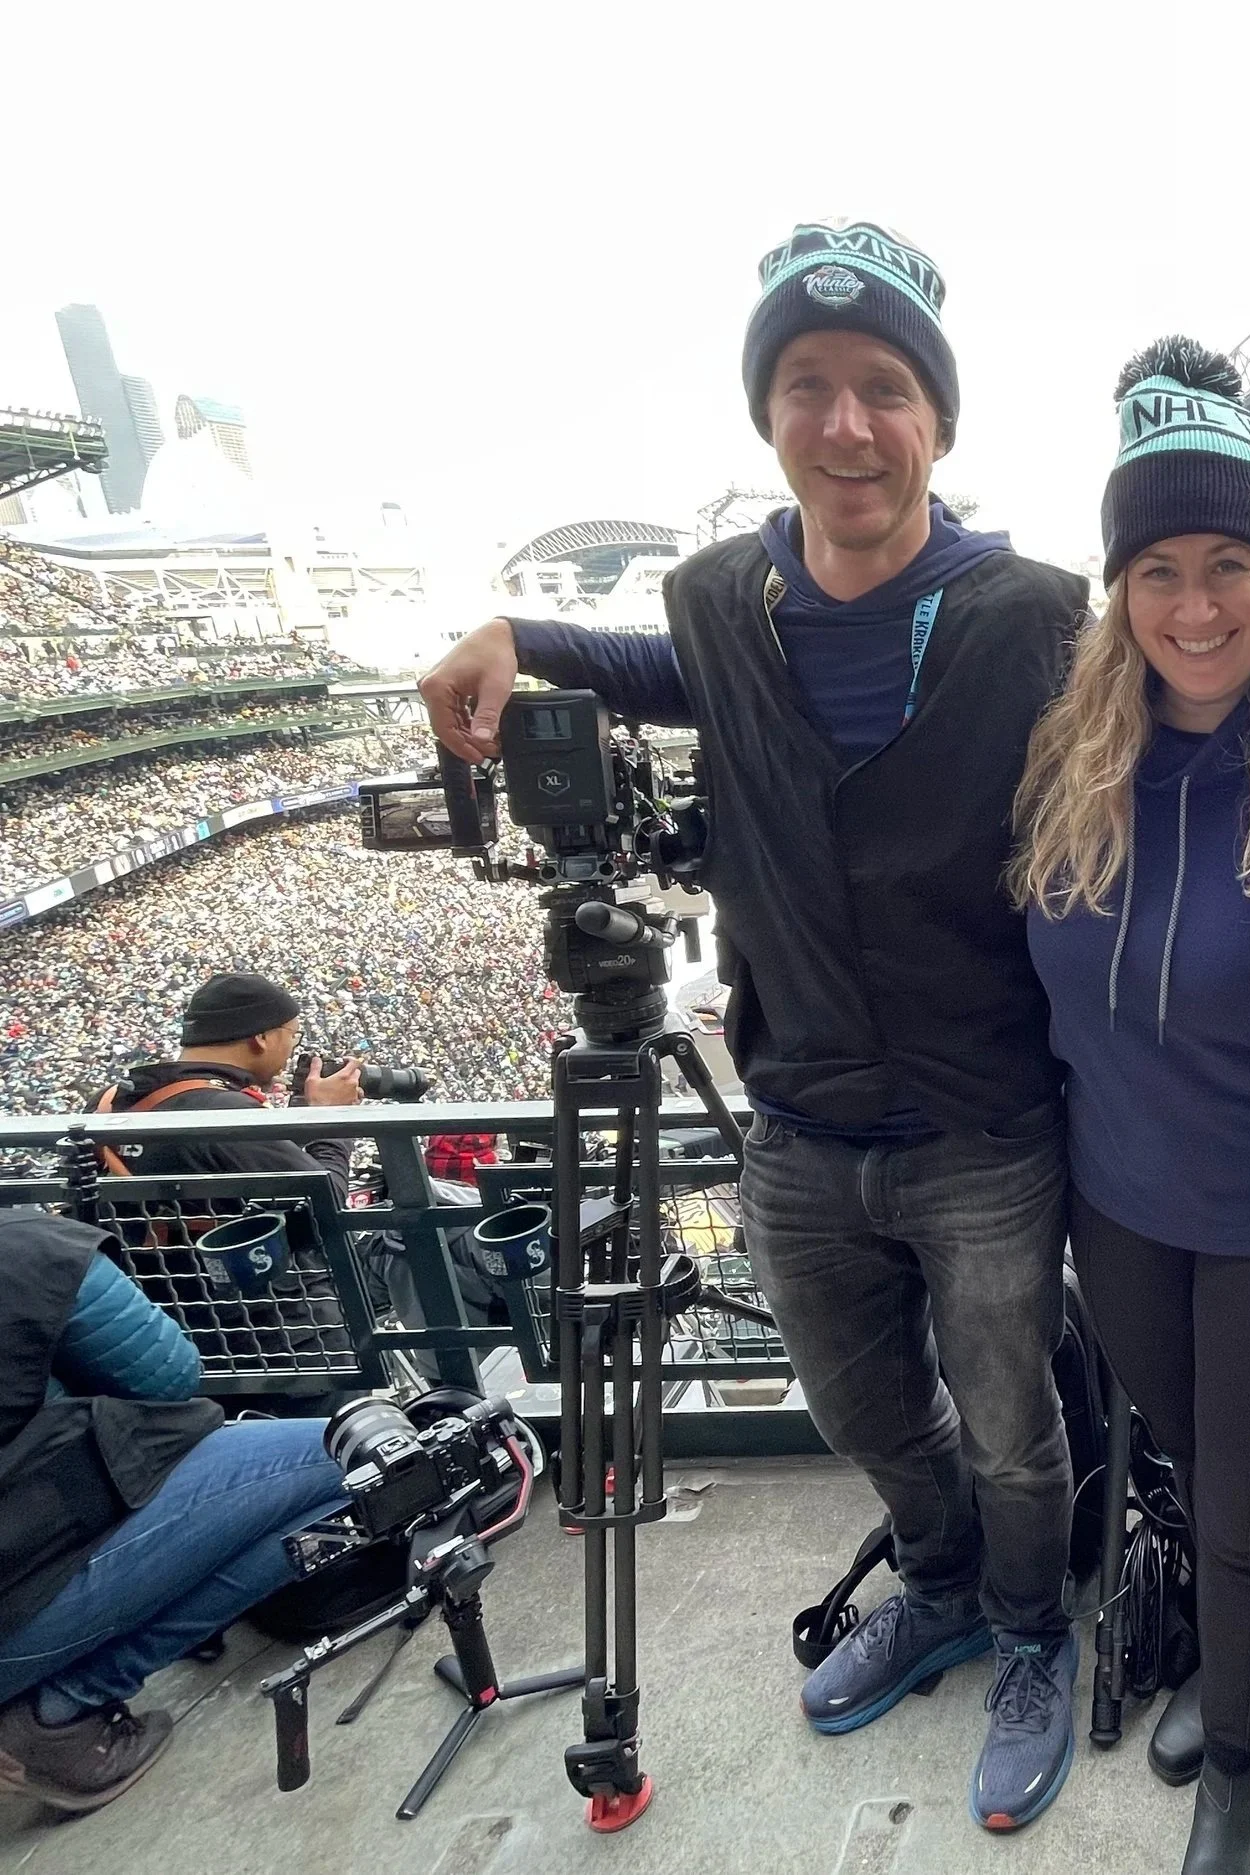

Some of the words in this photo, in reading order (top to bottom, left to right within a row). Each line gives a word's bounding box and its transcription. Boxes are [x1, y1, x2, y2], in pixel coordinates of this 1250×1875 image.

[1131, 395, 1227, 438] NHL
[913, 621, 929, 670] KRAKE
[545, 775, 562, 786] XL
